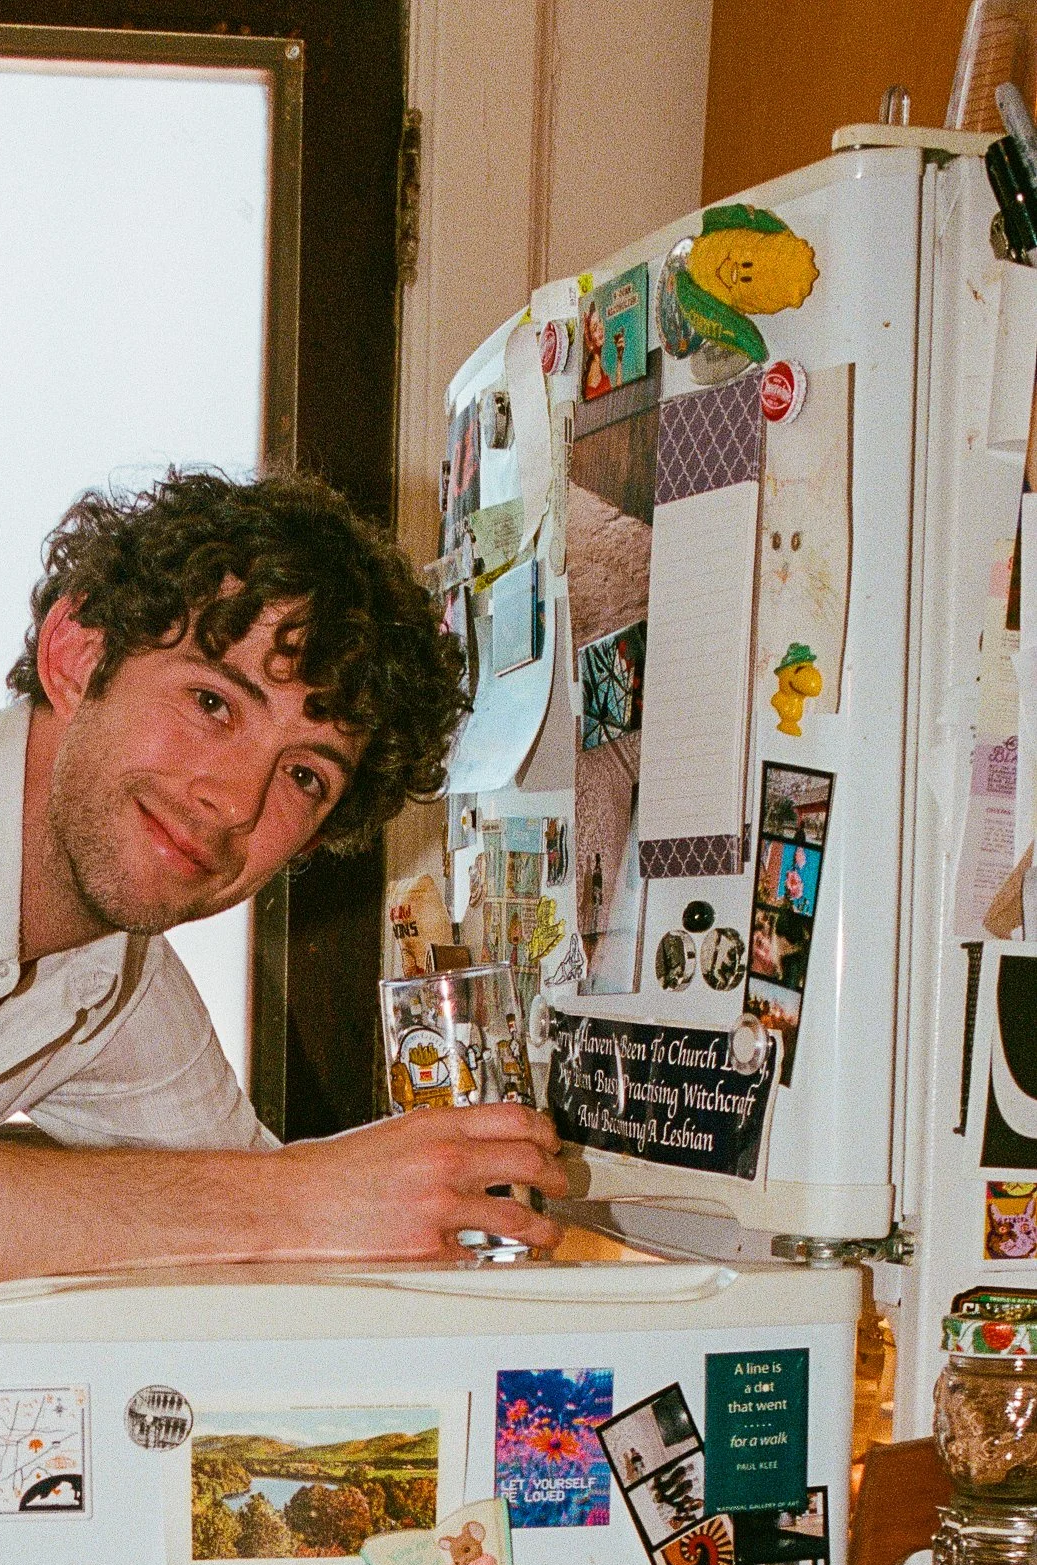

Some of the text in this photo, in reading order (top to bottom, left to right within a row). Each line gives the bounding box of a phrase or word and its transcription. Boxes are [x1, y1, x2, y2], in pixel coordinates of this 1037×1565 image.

[620, 1034, 646, 1062] Been
[650, 1033, 666, 1063] To
[668, 1036, 718, 1069] Church
[623, 1074, 679, 1119] Practising
[682, 1079, 759, 1129] Witchcraft
[578, 1102, 714, 1153] And Becoming A Lesbian
[734, 1361, 782, 1375] A line is
[744, 1381, 775, 1394] a dot
[728, 1399, 788, 1413] that went
[730, 1431, 788, 1448] for a walk
[736, 1460, 778, 1471] PAUL KLEE
[501, 1477, 597, 1491] LET YOURSELF
[524, 1491, 566, 1503] LOVED
